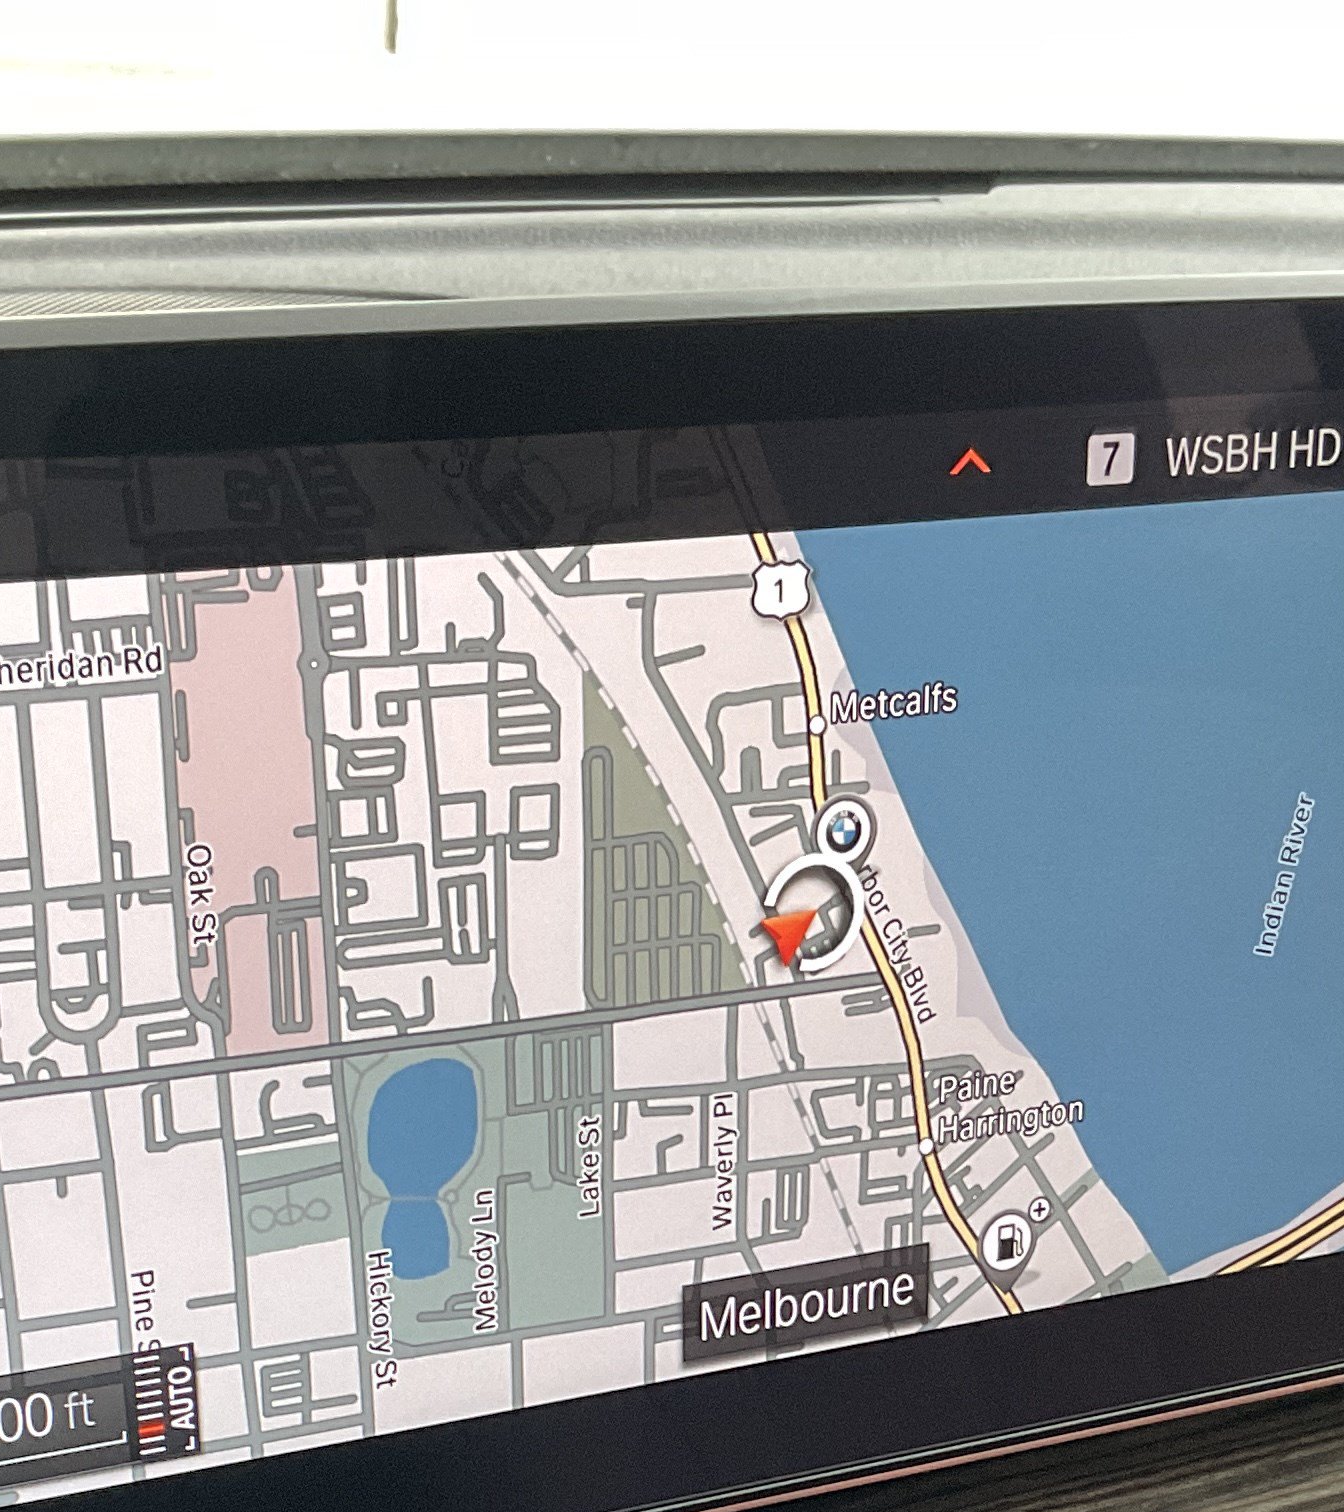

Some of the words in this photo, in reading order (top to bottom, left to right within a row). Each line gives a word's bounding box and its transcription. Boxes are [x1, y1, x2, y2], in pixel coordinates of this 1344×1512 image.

[1103, 442, 1120, 476] 7
[1166, 431, 1278, 477] WSBH
[774, 578, 784, 603] 1
[124, 646, 162, 674] Rd
[831, 681, 957, 724] Metcalfs
[187, 845, 213, 904] Oak
[1255, 873, 1293, 954] Indian
[1281, 794, 1313, 864] River
[191, 913, 217, 945] St
[857, 864, 890, 916] rbor
[882, 918, 912, 966] City
[905, 966, 937, 1024] Blvd
[714, 1093, 734, 1121] Pl
[940, 1070, 1015, 1103] Paine
[580, 1116, 601, 1146] St
[939, 1101, 1084, 1144] Harrington
[579, 1152, 601, 1217] Lake
[712, 1127, 738, 1231] Waverly
[472, 1189, 493, 1222] Ln
[131, 1270, 155, 1331] Pine
[368, 1250, 392, 1353] Hickory
[472, 1231, 497, 1331] Melody
[700, 1272, 915, 1341] Melbourne
[375, 1359, 398, 1389] St
[64, 1391, 96, 1430] ft
[167, 1366, 195, 1431] AUTO
